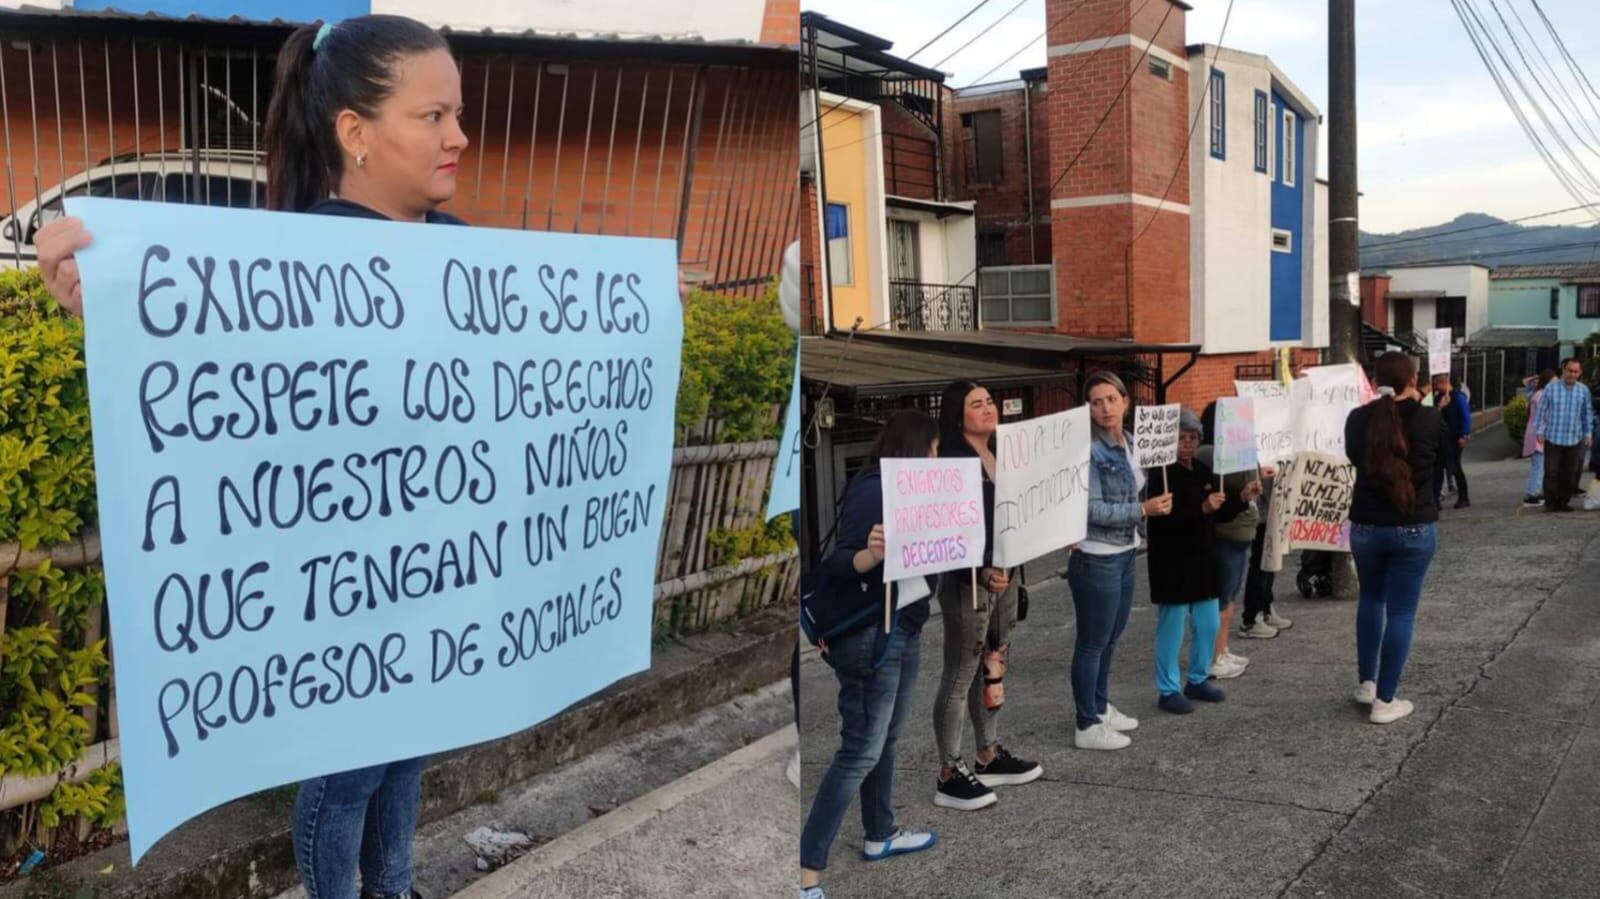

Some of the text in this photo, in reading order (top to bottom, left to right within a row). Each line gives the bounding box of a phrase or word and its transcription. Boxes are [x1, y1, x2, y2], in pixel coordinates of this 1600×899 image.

[137, 244, 650, 338] EXIGIMOS QUE SE LES
[138, 356, 654, 454] RESPETE LOS DERECHOS
[1002, 418, 1072, 473] NO A LA
[141, 417, 629, 553] A NUESTROS NIÑOS
[1304, 458, 1324, 477] NI
[153, 483, 656, 655] QUE TENGAN UN BUEN
[902, 535, 967, 569] DECENTES
[157, 566, 624, 759] PROFESOR DE SOCIALES
